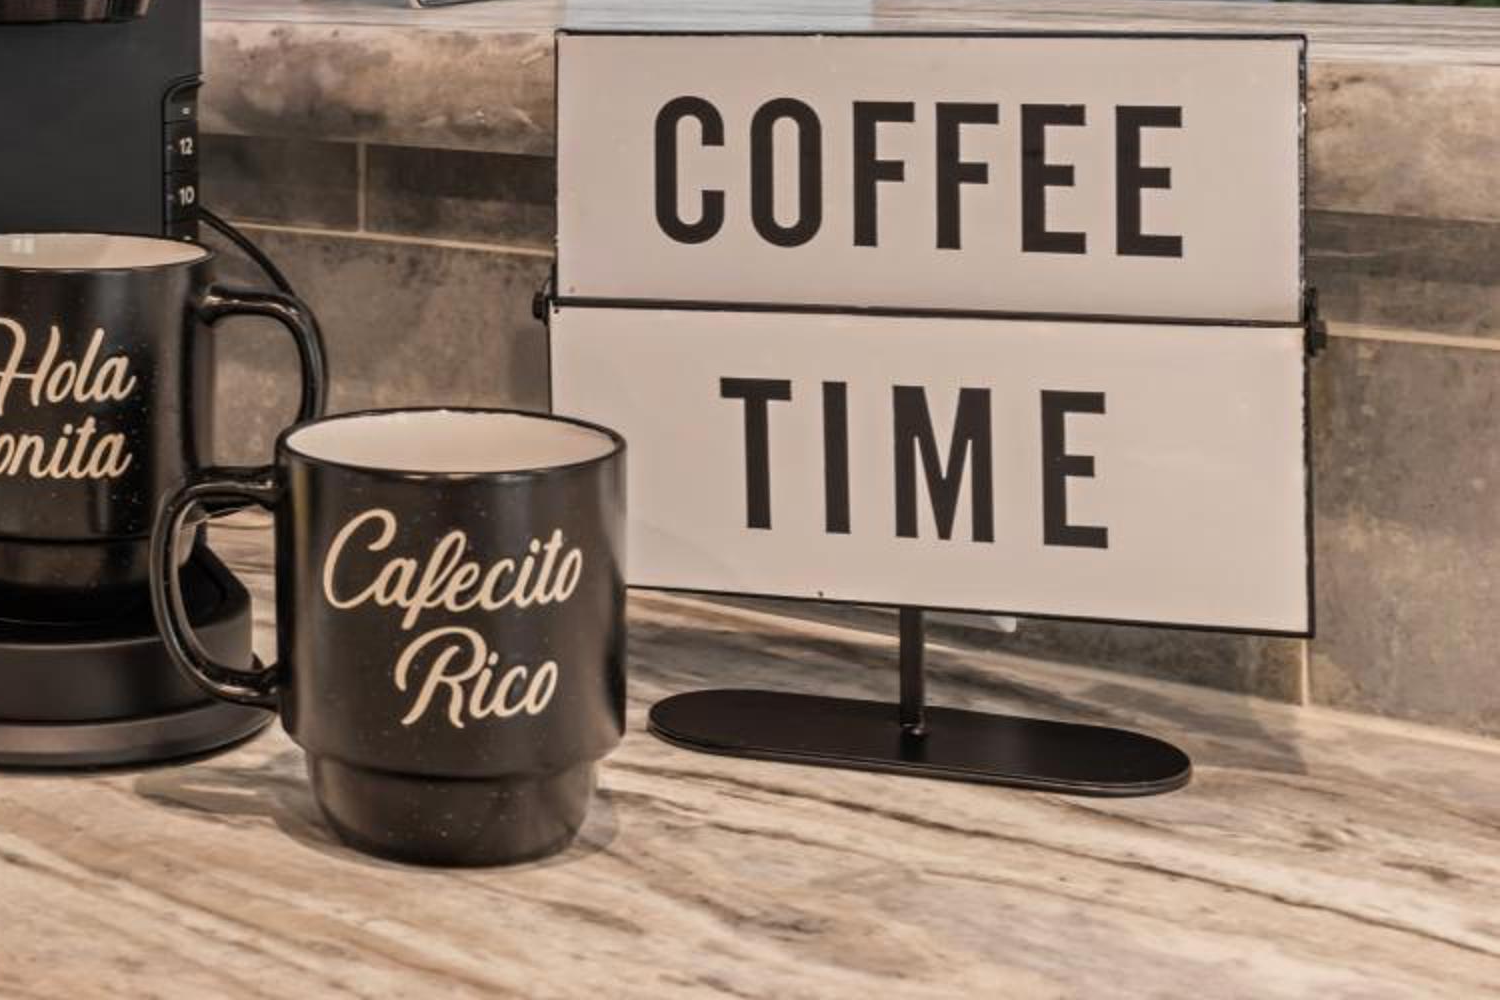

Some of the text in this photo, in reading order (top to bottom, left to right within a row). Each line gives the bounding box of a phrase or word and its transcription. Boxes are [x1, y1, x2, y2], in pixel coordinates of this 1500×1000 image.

[179, 136, 194, 156] 12
[179, 186, 195, 207] 10
[653, 94, 1184, 258] COFFEE
[719, 377, 1109, 550] TIME
[323, 508, 583, 630] Cafecito
[394, 626, 558, 729] Rico
